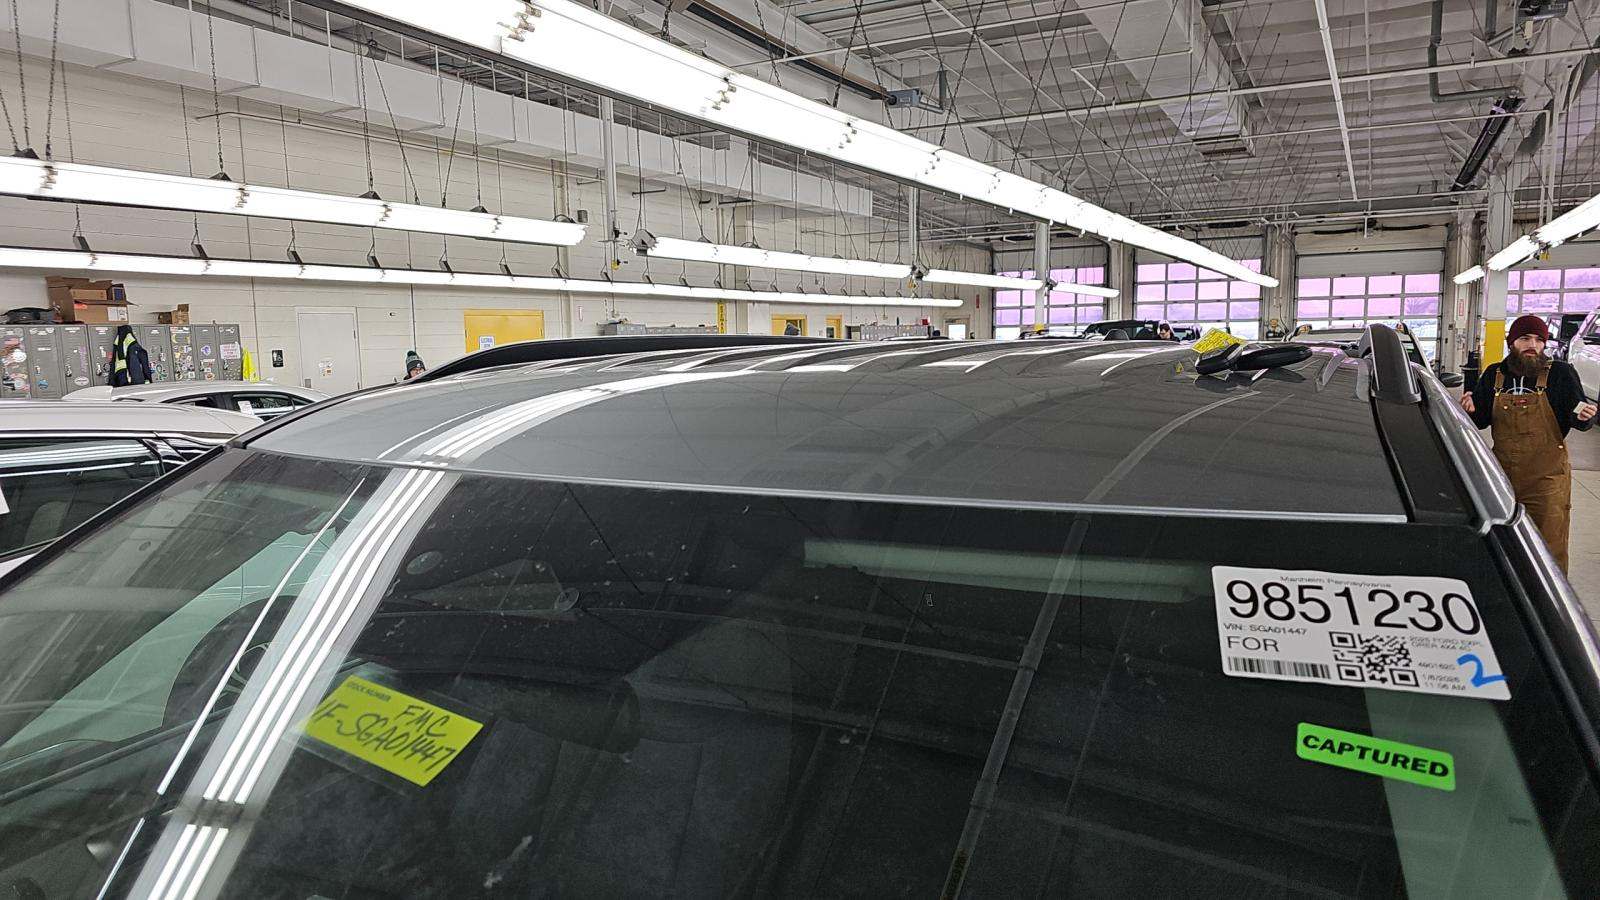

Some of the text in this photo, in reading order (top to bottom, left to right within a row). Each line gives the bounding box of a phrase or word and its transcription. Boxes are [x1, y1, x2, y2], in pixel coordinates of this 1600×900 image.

[1226, 579, 1481, 635] 9851230
[1227, 635, 1280, 652] FOR
[1457, 653, 1506, 688] 2
[396, 704, 450, 738] FMC
[1302, 734, 1449, 777] CAPTURED
